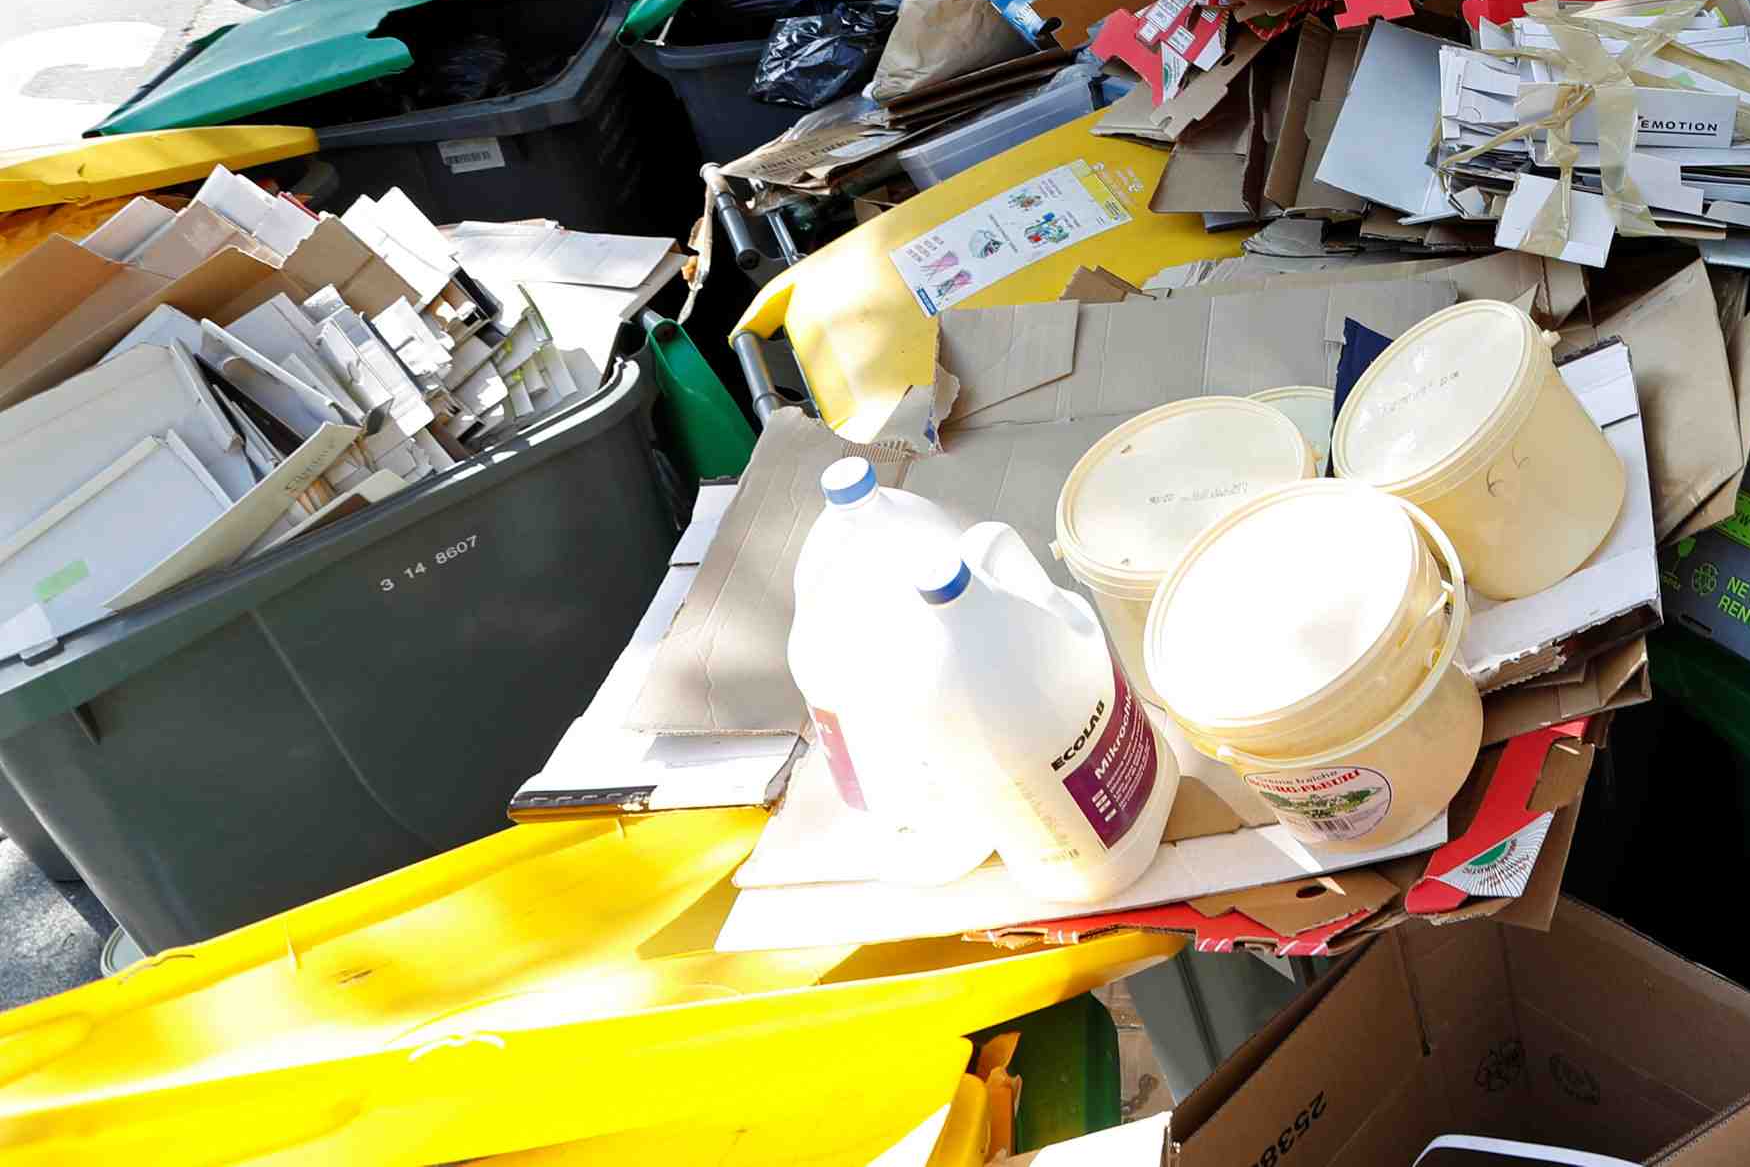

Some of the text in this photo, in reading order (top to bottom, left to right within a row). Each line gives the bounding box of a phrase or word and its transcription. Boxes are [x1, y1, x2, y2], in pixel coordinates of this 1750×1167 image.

[380, 535, 479, 591] 3 14 8607
[1727, 576, 1749, 599] NE
[1051, 700, 1105, 772] ECOLAB
